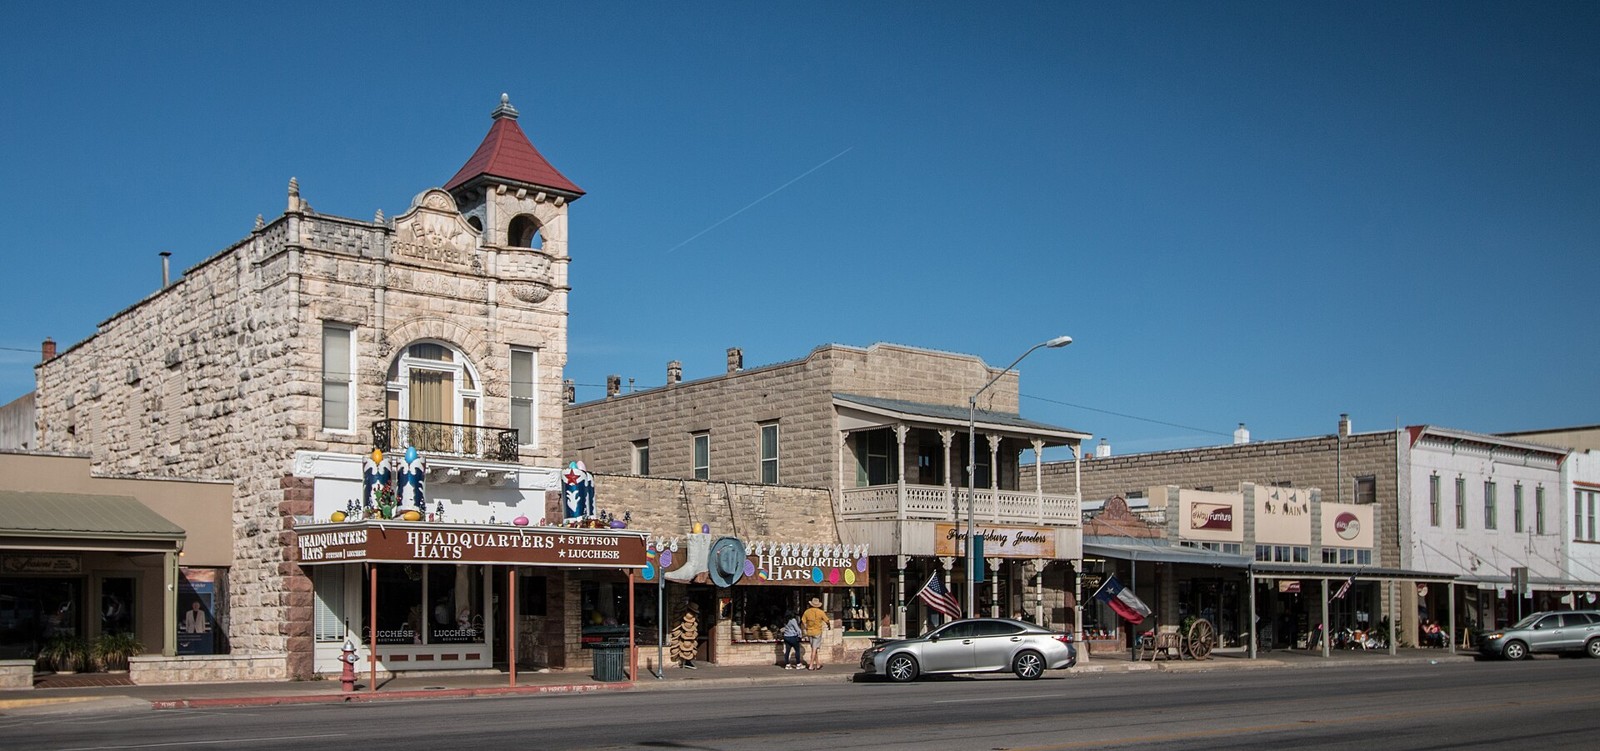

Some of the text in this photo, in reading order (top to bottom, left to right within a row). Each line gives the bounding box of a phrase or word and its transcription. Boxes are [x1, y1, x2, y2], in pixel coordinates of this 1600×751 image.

[298, 529, 367, 548] HEADQUARTERS
[406, 531, 555, 549] HEADQUARTERS
[568, 535, 619, 546] STETSON
[1012, 530, 1047, 546] Jewelers
[302, 546, 323, 560] HATS
[413, 545, 463, 559] HATS
[568, 549, 620, 559] LUCCHESE
[757, 554, 852, 570] HEADQUARTERS
[767, 565, 812, 581] HATS
[434, 629, 477, 637] LUCCHESE
